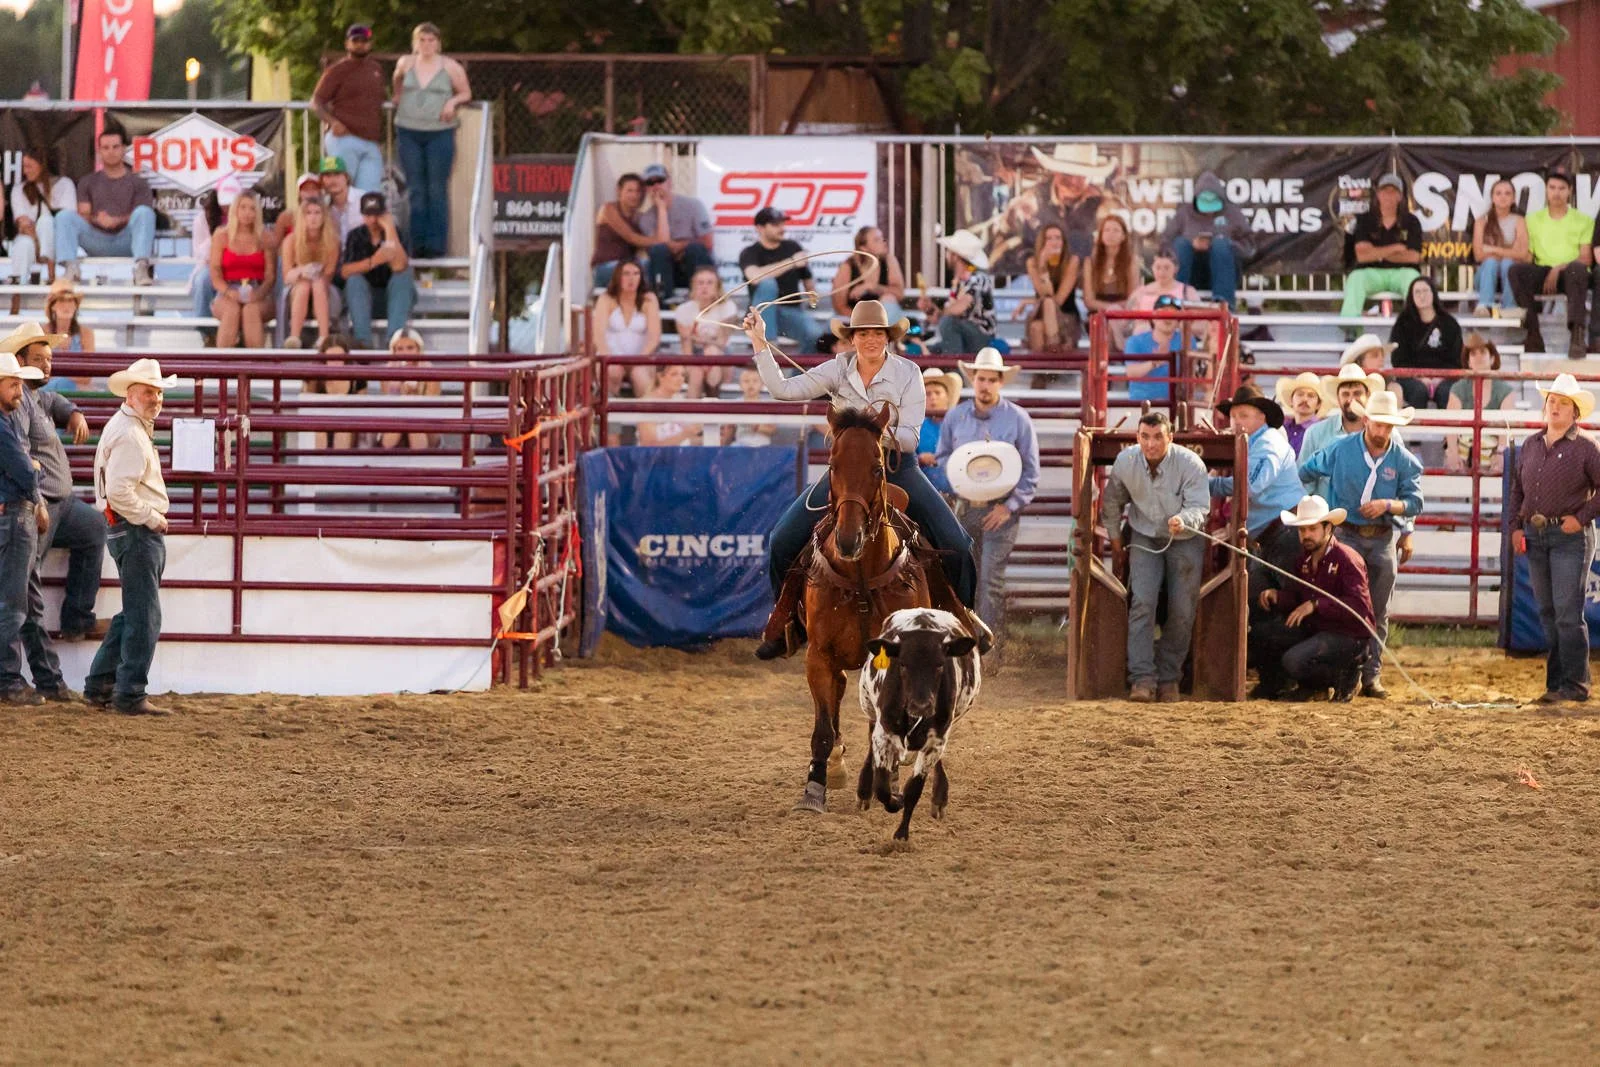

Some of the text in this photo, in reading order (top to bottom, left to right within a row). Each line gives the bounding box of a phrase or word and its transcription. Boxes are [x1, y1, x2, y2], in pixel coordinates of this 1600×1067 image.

[132, 135, 256, 172] RON'S
[816, 216, 857, 227] LLC
[638, 534, 765, 557] CINCH
